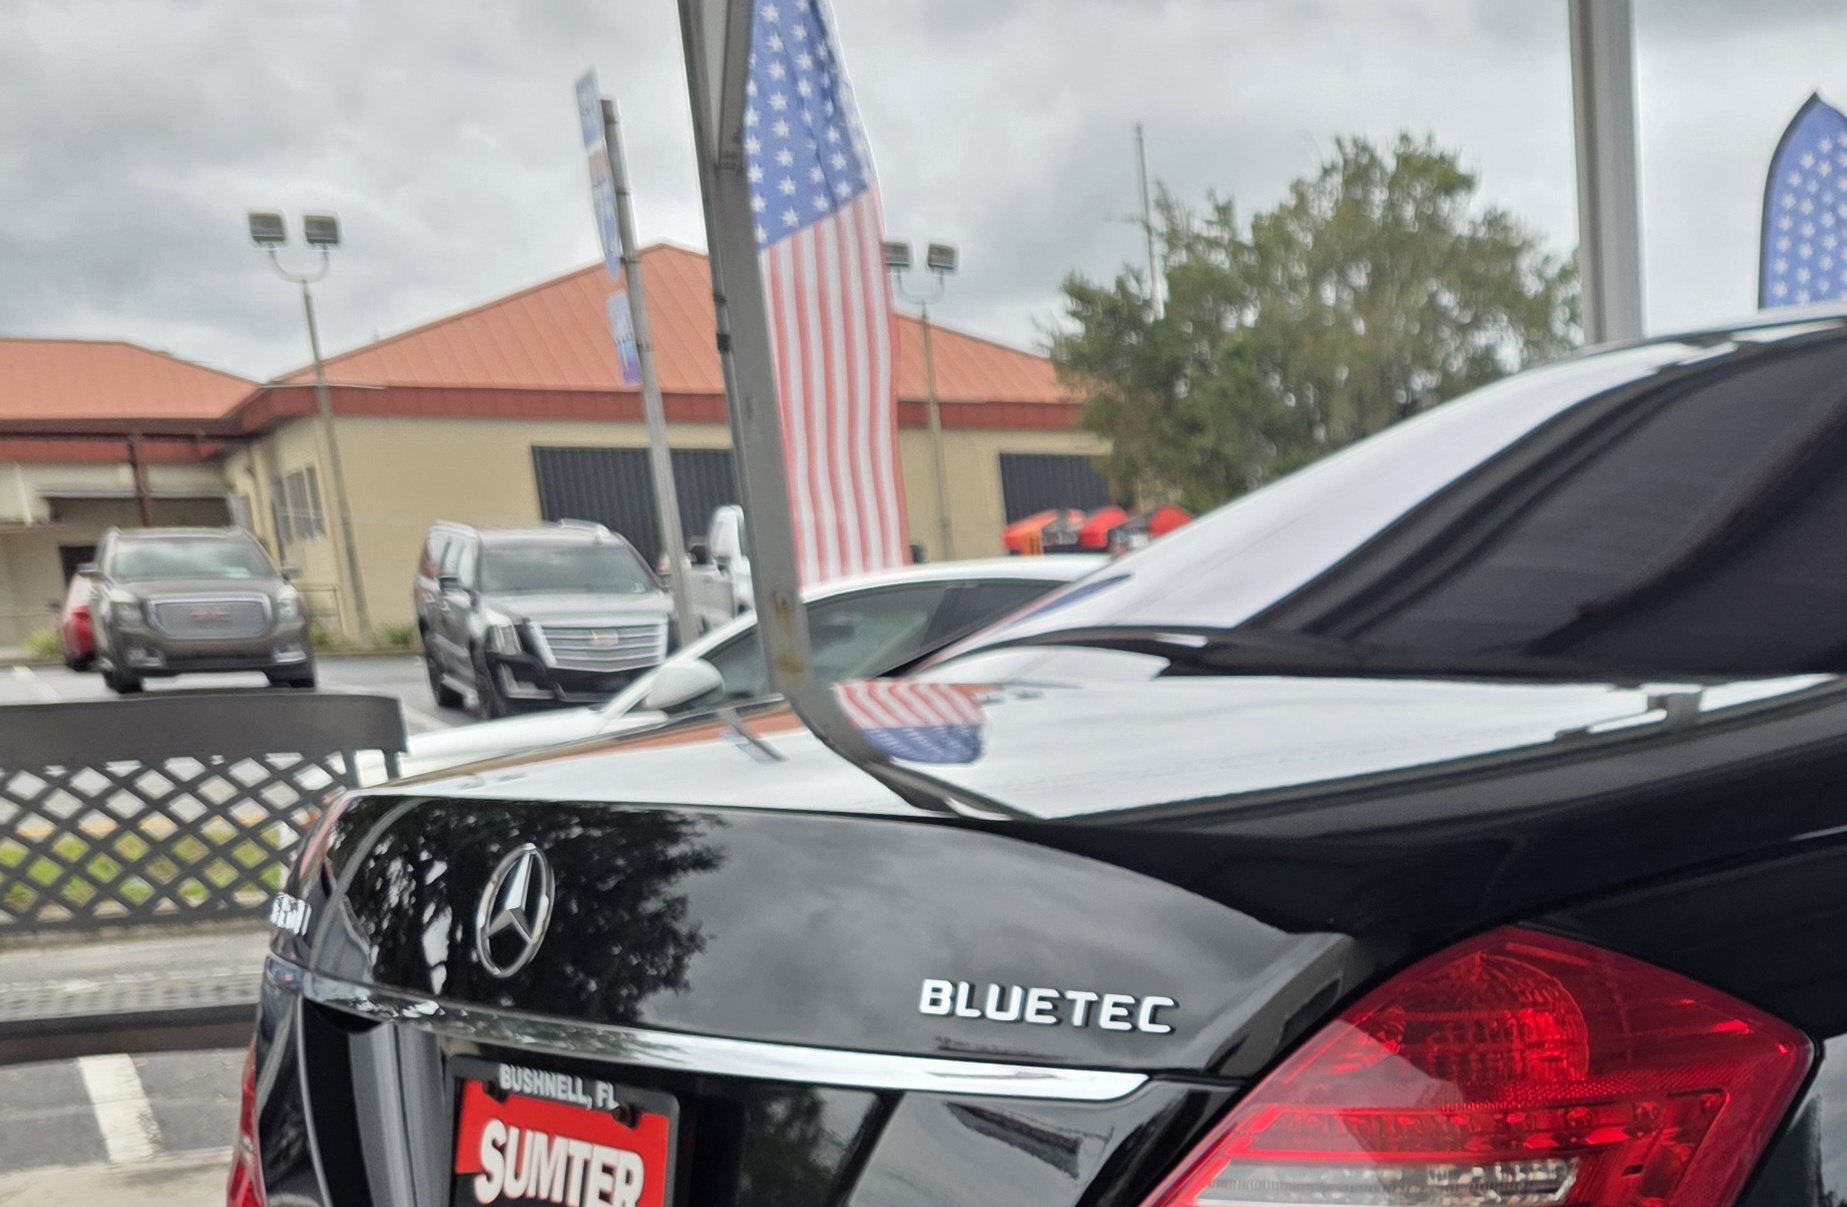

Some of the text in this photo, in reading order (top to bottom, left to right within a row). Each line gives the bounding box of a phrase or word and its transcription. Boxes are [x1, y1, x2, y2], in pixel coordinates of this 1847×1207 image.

[919, 978, 1178, 1034] BLUETEC
[499, 1063, 620, 1111] BUSHNELL, FL
